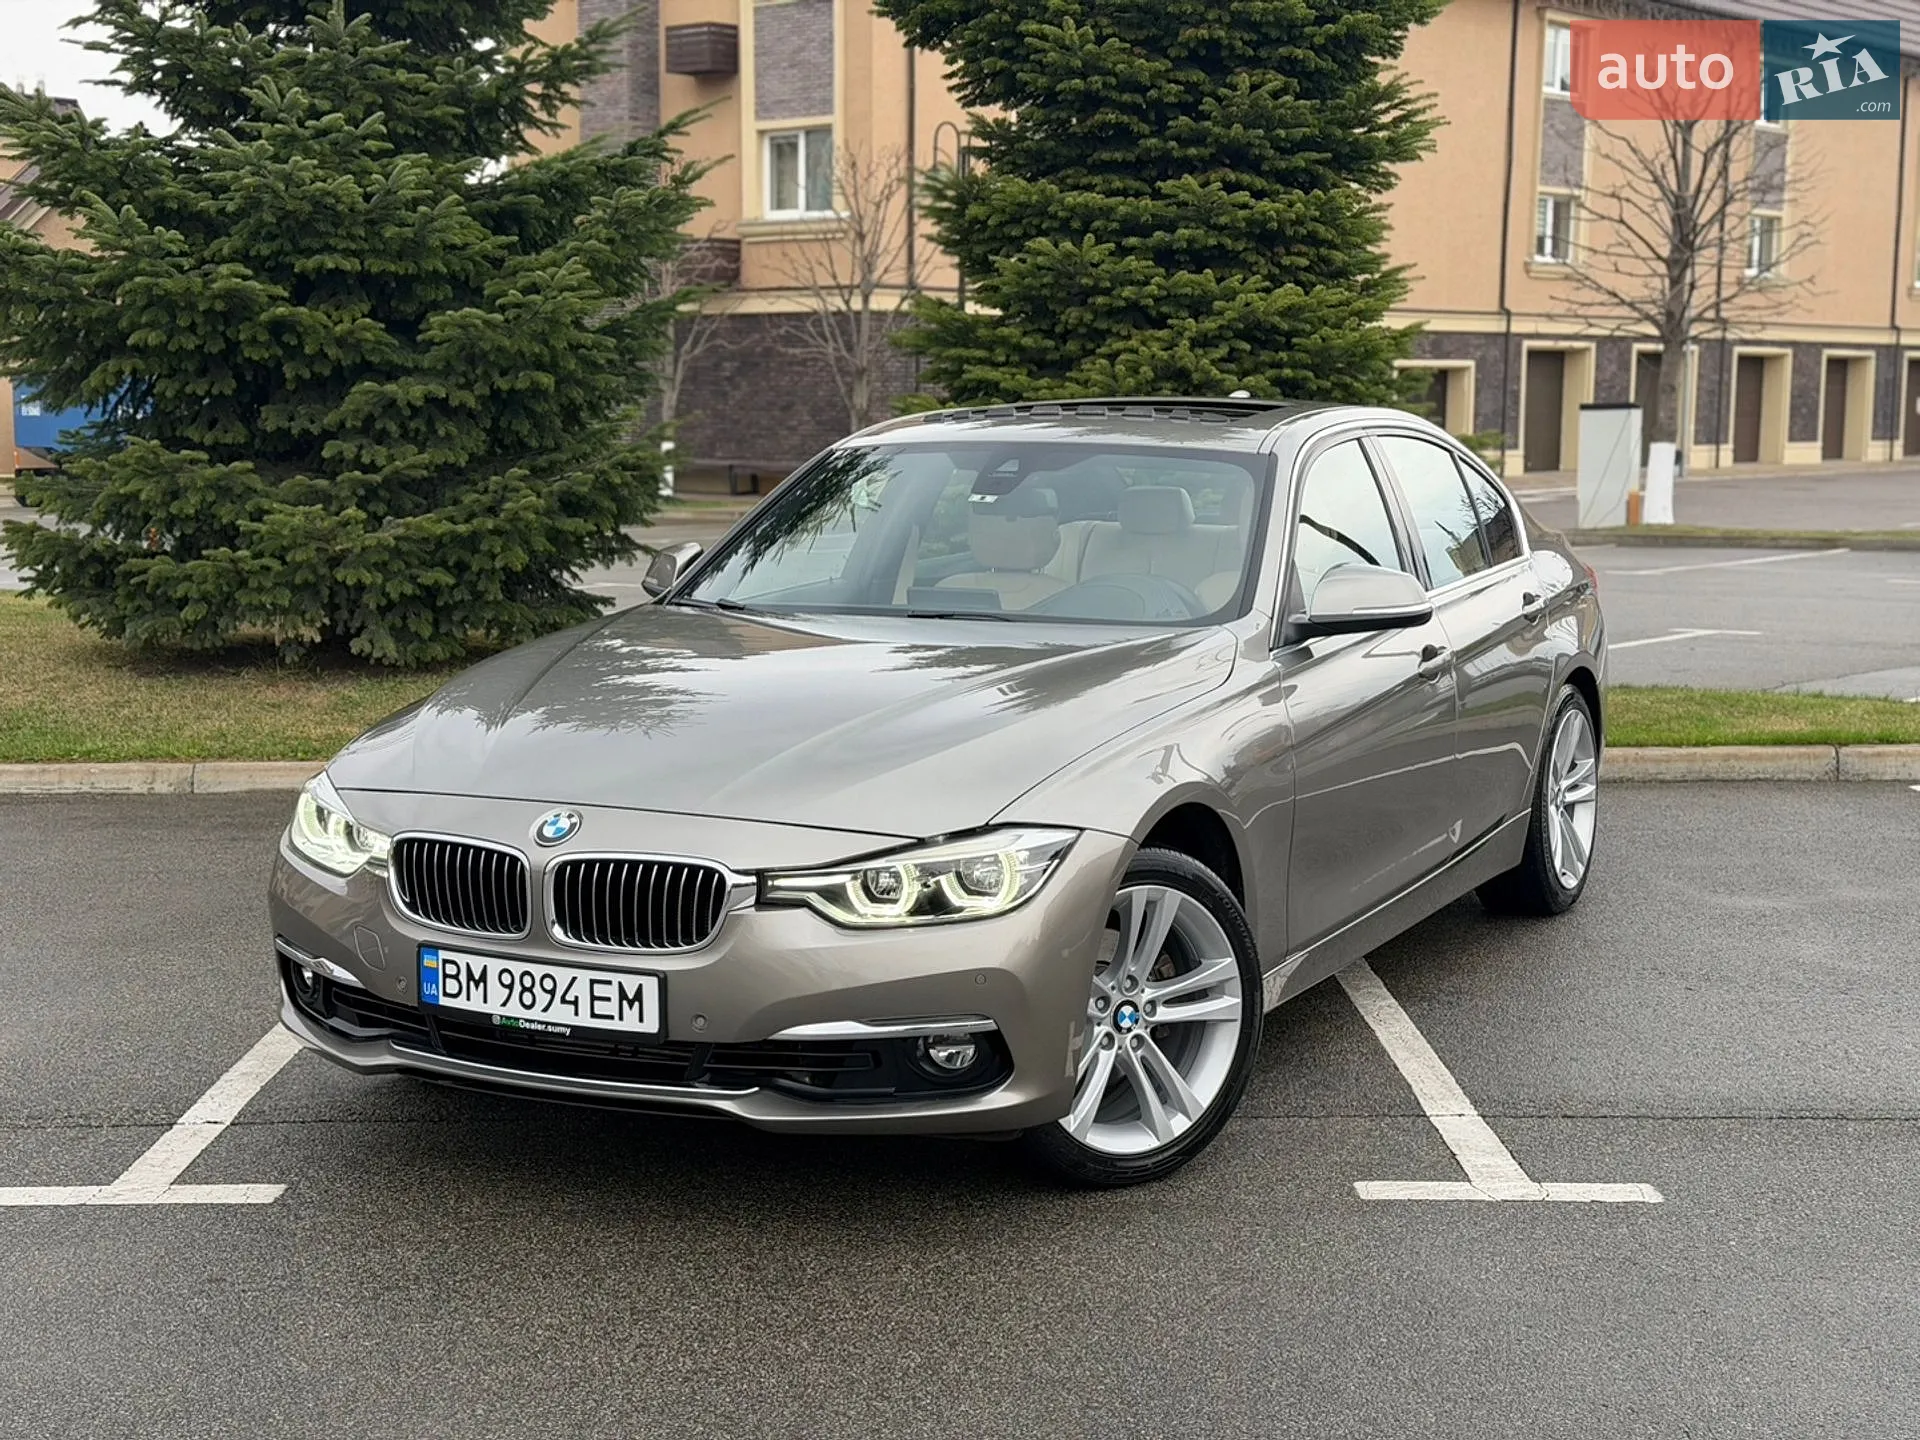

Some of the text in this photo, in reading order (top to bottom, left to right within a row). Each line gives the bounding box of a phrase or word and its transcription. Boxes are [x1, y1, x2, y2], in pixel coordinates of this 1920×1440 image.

[423, 981, 438, 996] UA
[441, 958, 644, 1024] BM 9894 EM
